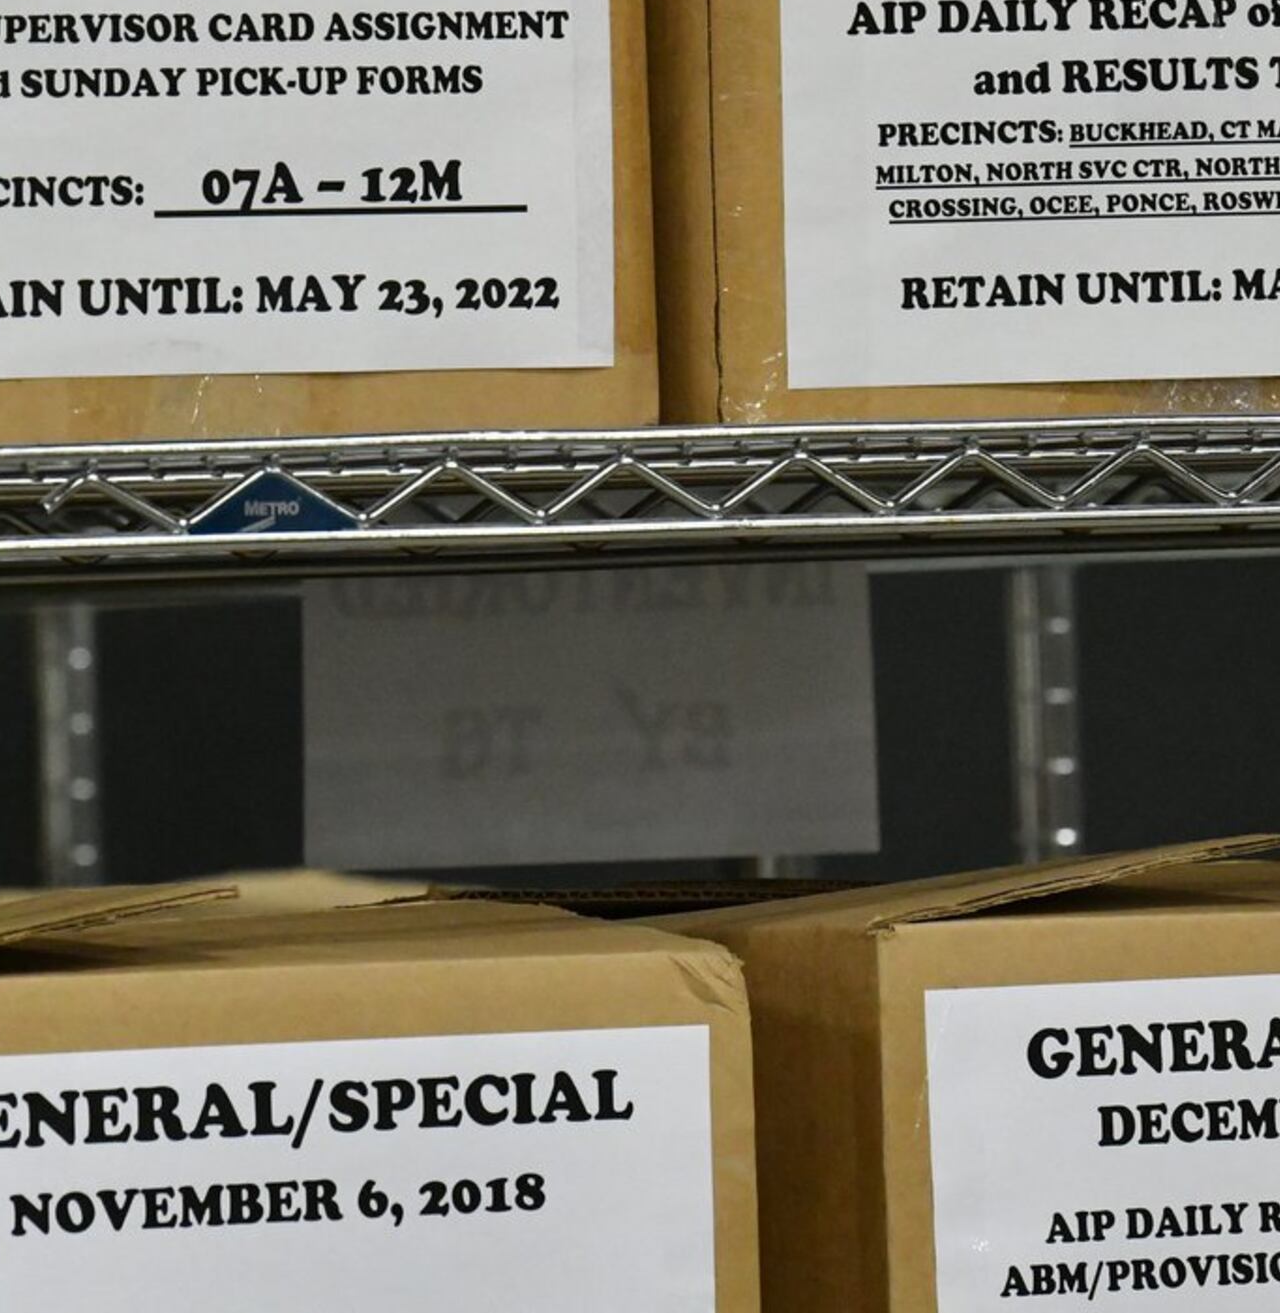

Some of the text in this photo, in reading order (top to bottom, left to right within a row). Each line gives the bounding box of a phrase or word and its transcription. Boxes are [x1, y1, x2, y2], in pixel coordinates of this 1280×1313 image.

[209, 13, 314, 42] CARD
[324, 11, 569, 41] ASSIGNMENT
[847, 1, 926, 35] AIP
[21, 68, 186, 98] SUNDAY
[196, 67, 347, 96] PICK-UP
[357, 65, 482, 94] FORMS
[974, 61, 1051, 95] and
[1062, 57, 1259, 93] RESULTS
[878, 120, 1063, 147] PRECINCTS:
[1069, 121, 1215, 143] BUCKHEAD,
[1220, 120, 1251, 138] CT
[202, 161, 303, 212] 07A
[361, 160, 462, 203] 12M
[875, 163, 981, 185] MILTON,
[986, 161, 1073, 182] NORTH
[1078, 160, 1127, 179] SVC
[1133, 158, 1190, 180] CTR,
[888, 197, 1023, 219] CROSSING,
[1029, 195, 1100, 217] OCEE,
[1106, 192, 1198, 215] PONCE,
[78, 277, 243, 316] UNTIL:
[256, 274, 366, 313] MAY
[378, 280, 443, 318] 23,
[456, 277, 559, 310] 2022
[244, 501, 299, 516] METRO
[10, 1179, 343, 1236] NOVEMBER
[358, 1180, 403, 1227] 6,
[419, 1173, 545, 1216] 2018
[1046, 1210, 1115, 1244] AIP
[1126, 1203, 1248, 1239] DAILY
